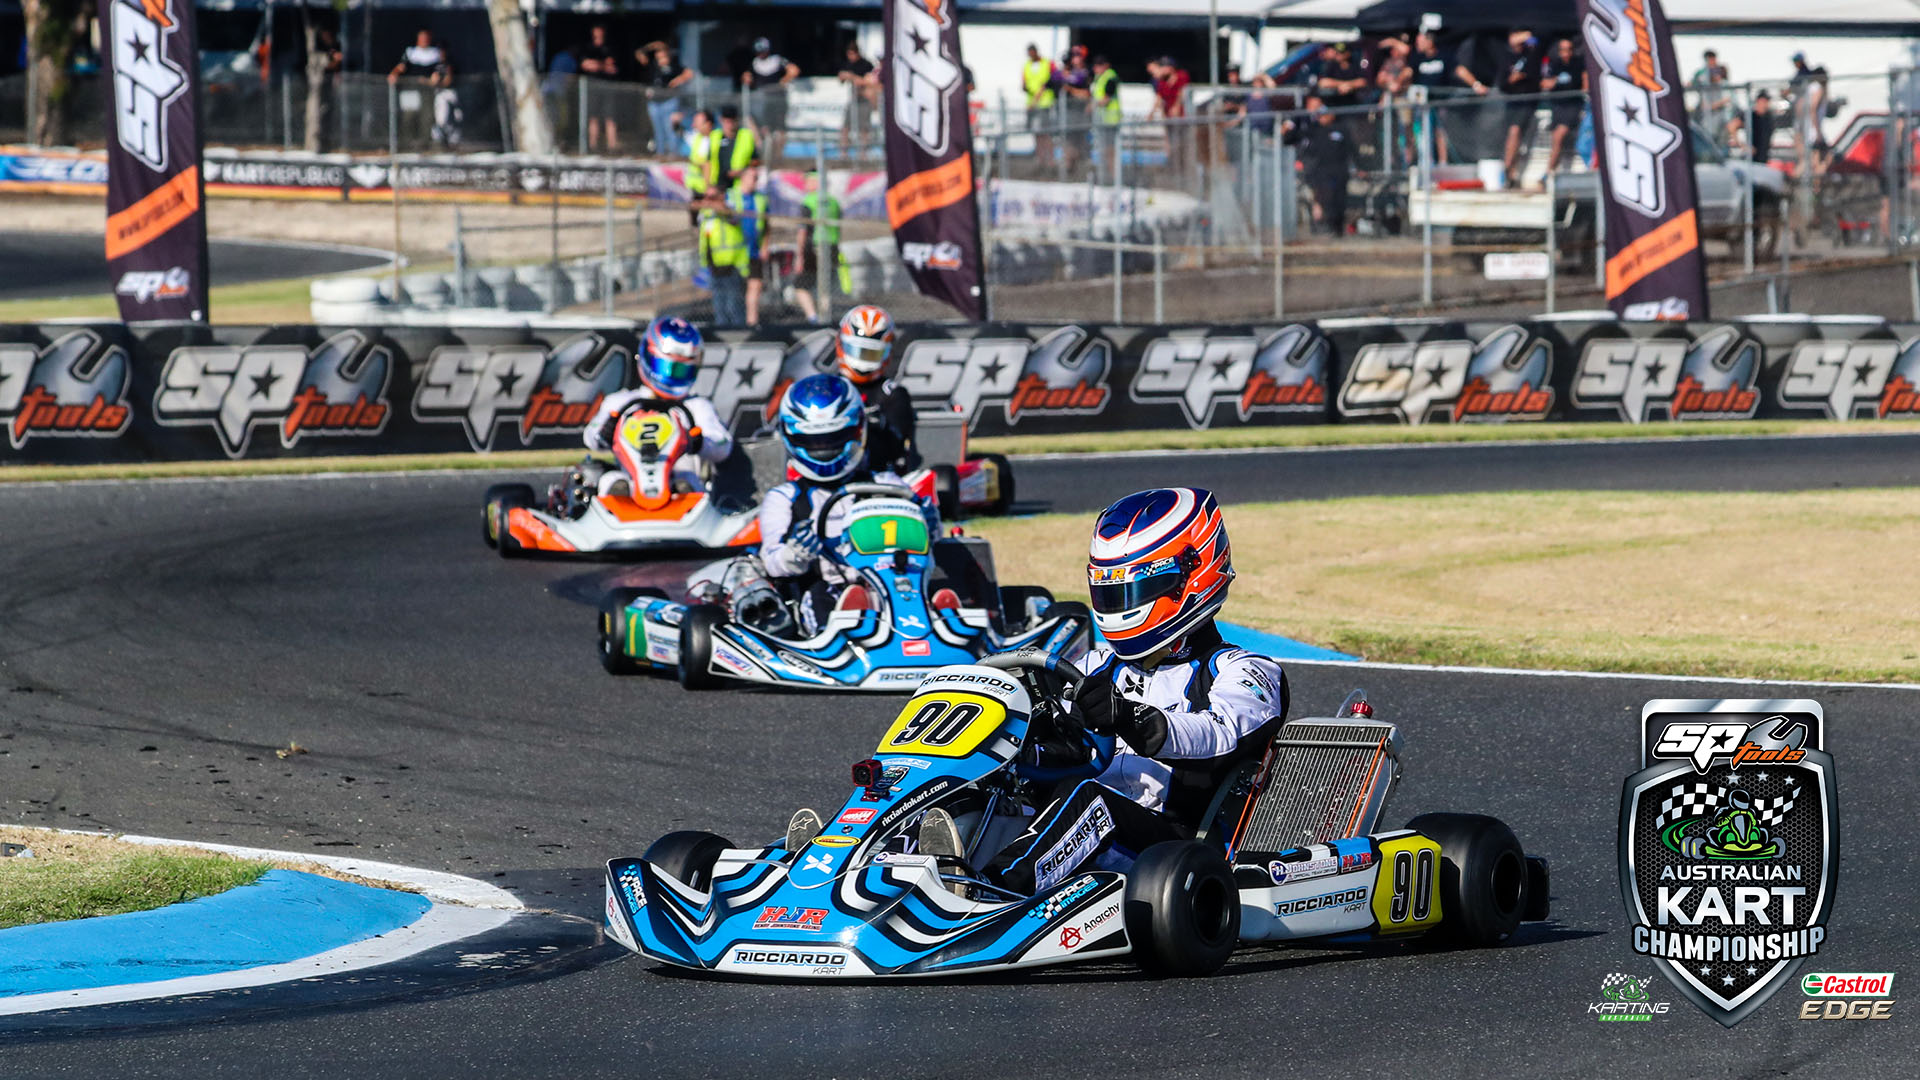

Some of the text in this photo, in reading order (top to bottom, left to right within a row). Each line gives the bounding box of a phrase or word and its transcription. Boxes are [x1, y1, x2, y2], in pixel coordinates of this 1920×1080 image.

[115, 1, 182, 164] SP
[895, 0, 958, 148] SP
[1606, 74, 1674, 210] SP
[418, 351, 606, 443] SP tool
[901, 343, 1105, 416] SP tools
[1136, 342, 1335, 420] SP tools
[1345, 346, 1552, 425] SP tools
[1577, 342, 1757, 423] SP tools
[1784, 343, 1900, 420] SP
[14, 385, 128, 439] tools
[158, 351, 387, 447] SP tools
[640, 423, 660, 440] 2
[881, 520, 897, 545] 1
[1093, 568, 1126, 581] HJR
[880, 672, 928, 681] RICCIA
[920, 674, 1016, 692] RICCIARDO
[983, 685, 1010, 697] KART
[890, 700, 984, 747] 90
[881, 780, 949, 827] ricciardokart.com
[1054, 874, 1096, 902] PACE
[1060, 881, 1099, 909] IMAGES
[1276, 887, 1367, 916] RICCIARDO
[1389, 848, 1434, 922] 90
[756, 906, 829, 925] HJR
[1083, 902, 1120, 932] Anarchy
[1344, 902, 1367, 914] KART
[735, 951, 847, 966] RICCIARDO
[812, 967, 845, 975] KART
